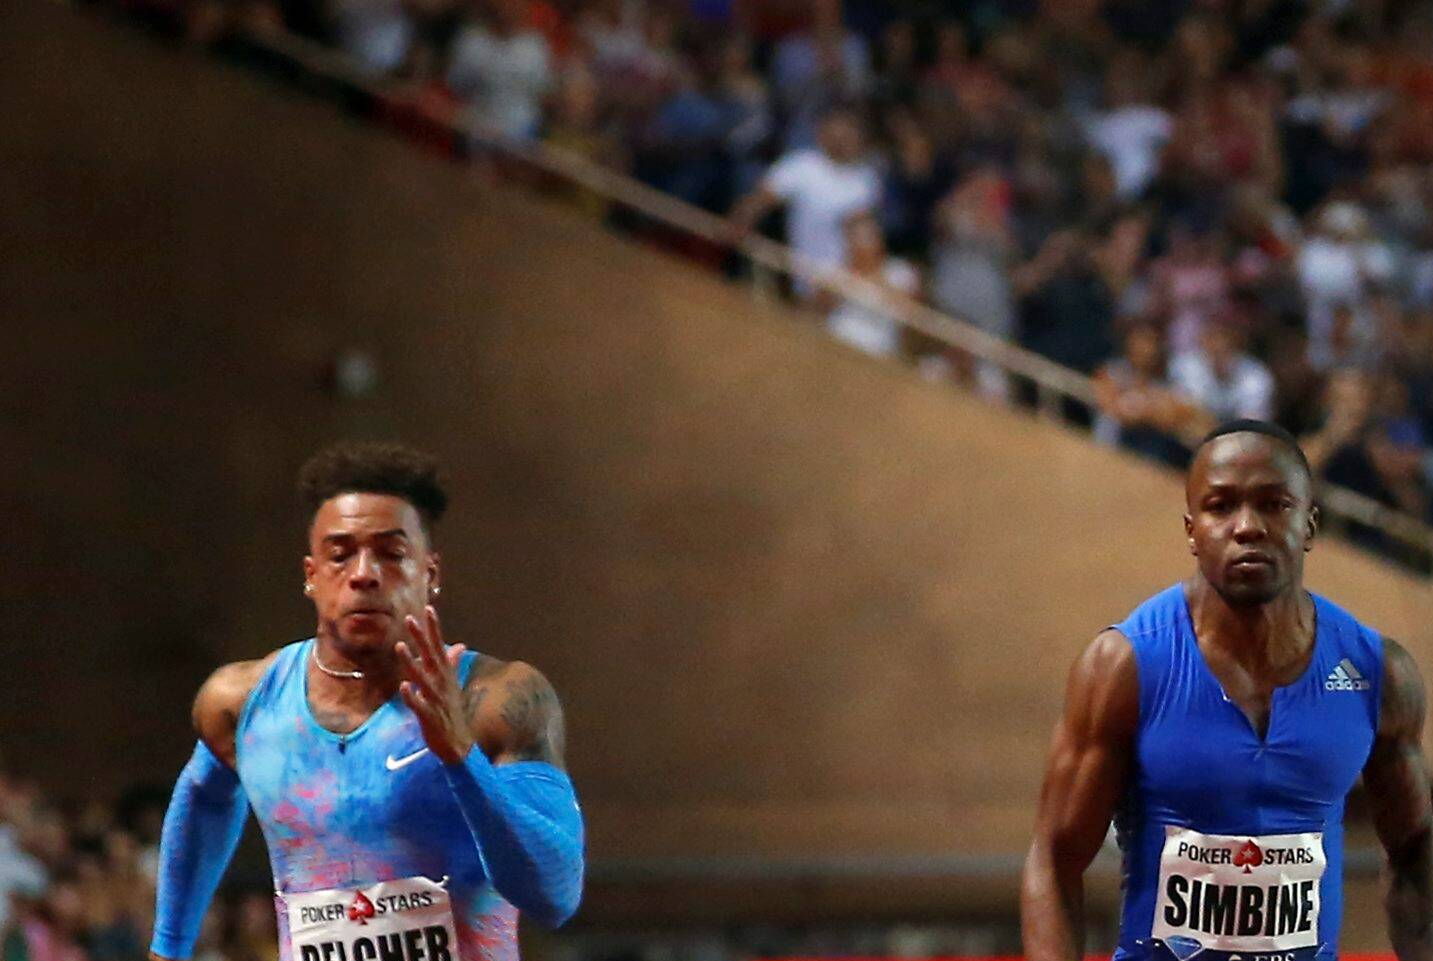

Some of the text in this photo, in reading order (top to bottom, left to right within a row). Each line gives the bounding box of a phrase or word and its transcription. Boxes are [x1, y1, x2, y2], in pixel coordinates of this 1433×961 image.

[1177, 841, 1314, 865] POKER STARS
[301, 891, 432, 923] POKER STARS
[1164, 874, 1314, 937] SIMBINE
